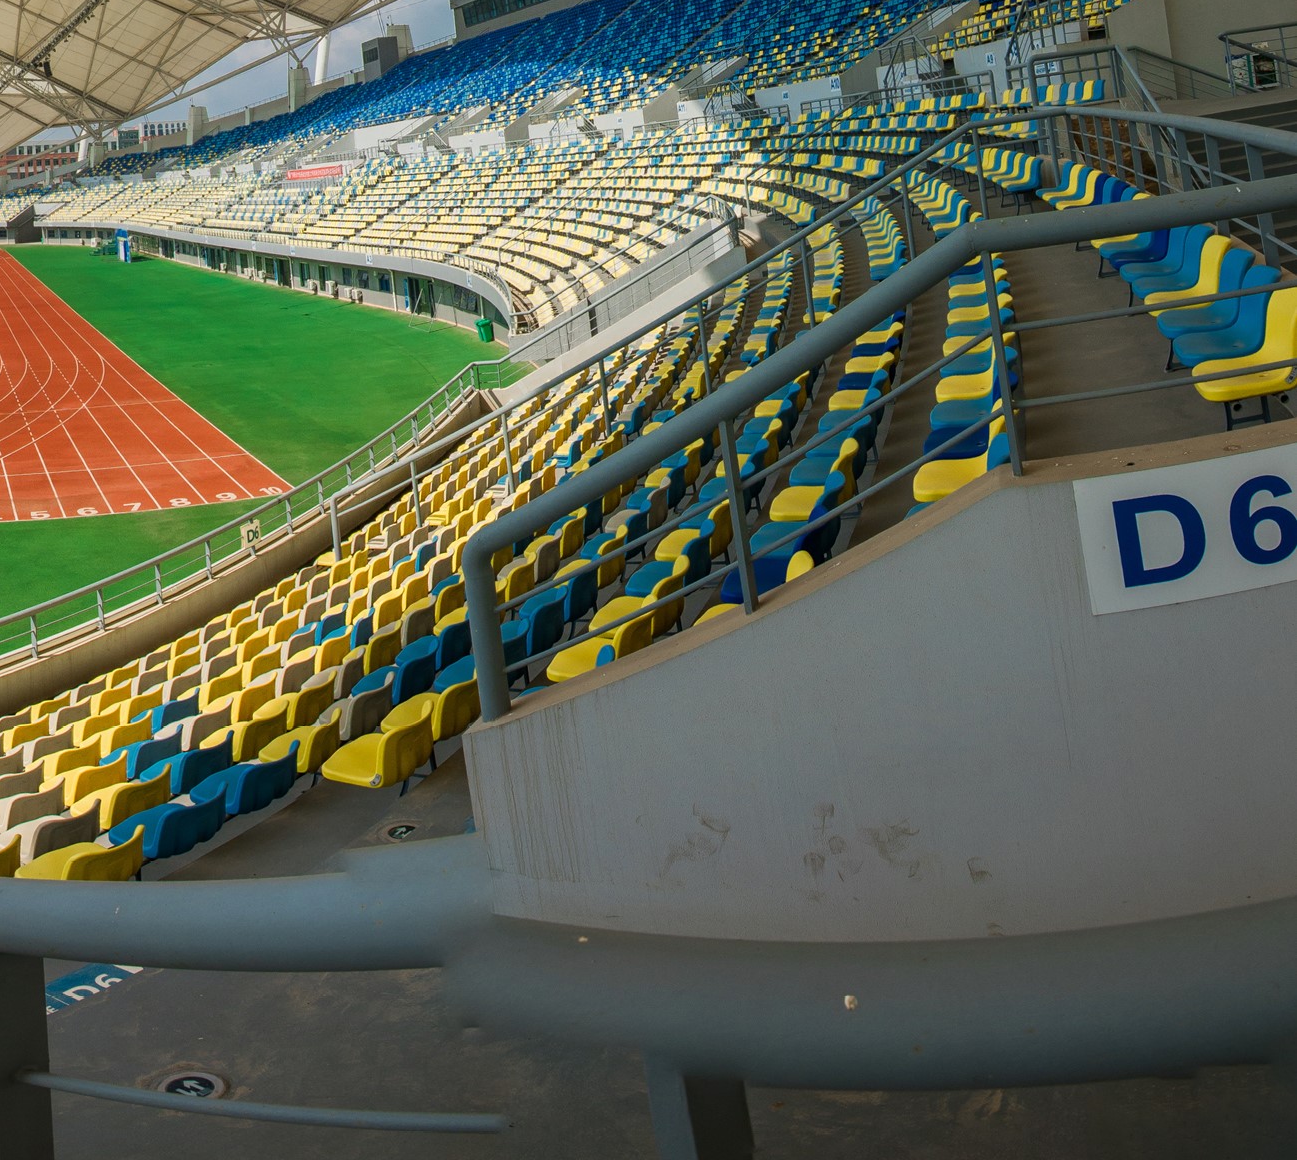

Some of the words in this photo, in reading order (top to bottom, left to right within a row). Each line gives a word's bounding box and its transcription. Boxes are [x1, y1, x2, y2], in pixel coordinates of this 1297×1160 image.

[259, 486, 282, 496] 10
[215, 492, 237, 501] 9
[123, 502, 142, 512] 7
[169, 497, 191, 507] 8
[30, 510, 50, 520] 5
[76, 507, 98, 516] 6
[246, 525, 260, 544] D6
[1112, 474, 1297, 588] D6
[62, 973, 123, 1001] D6
